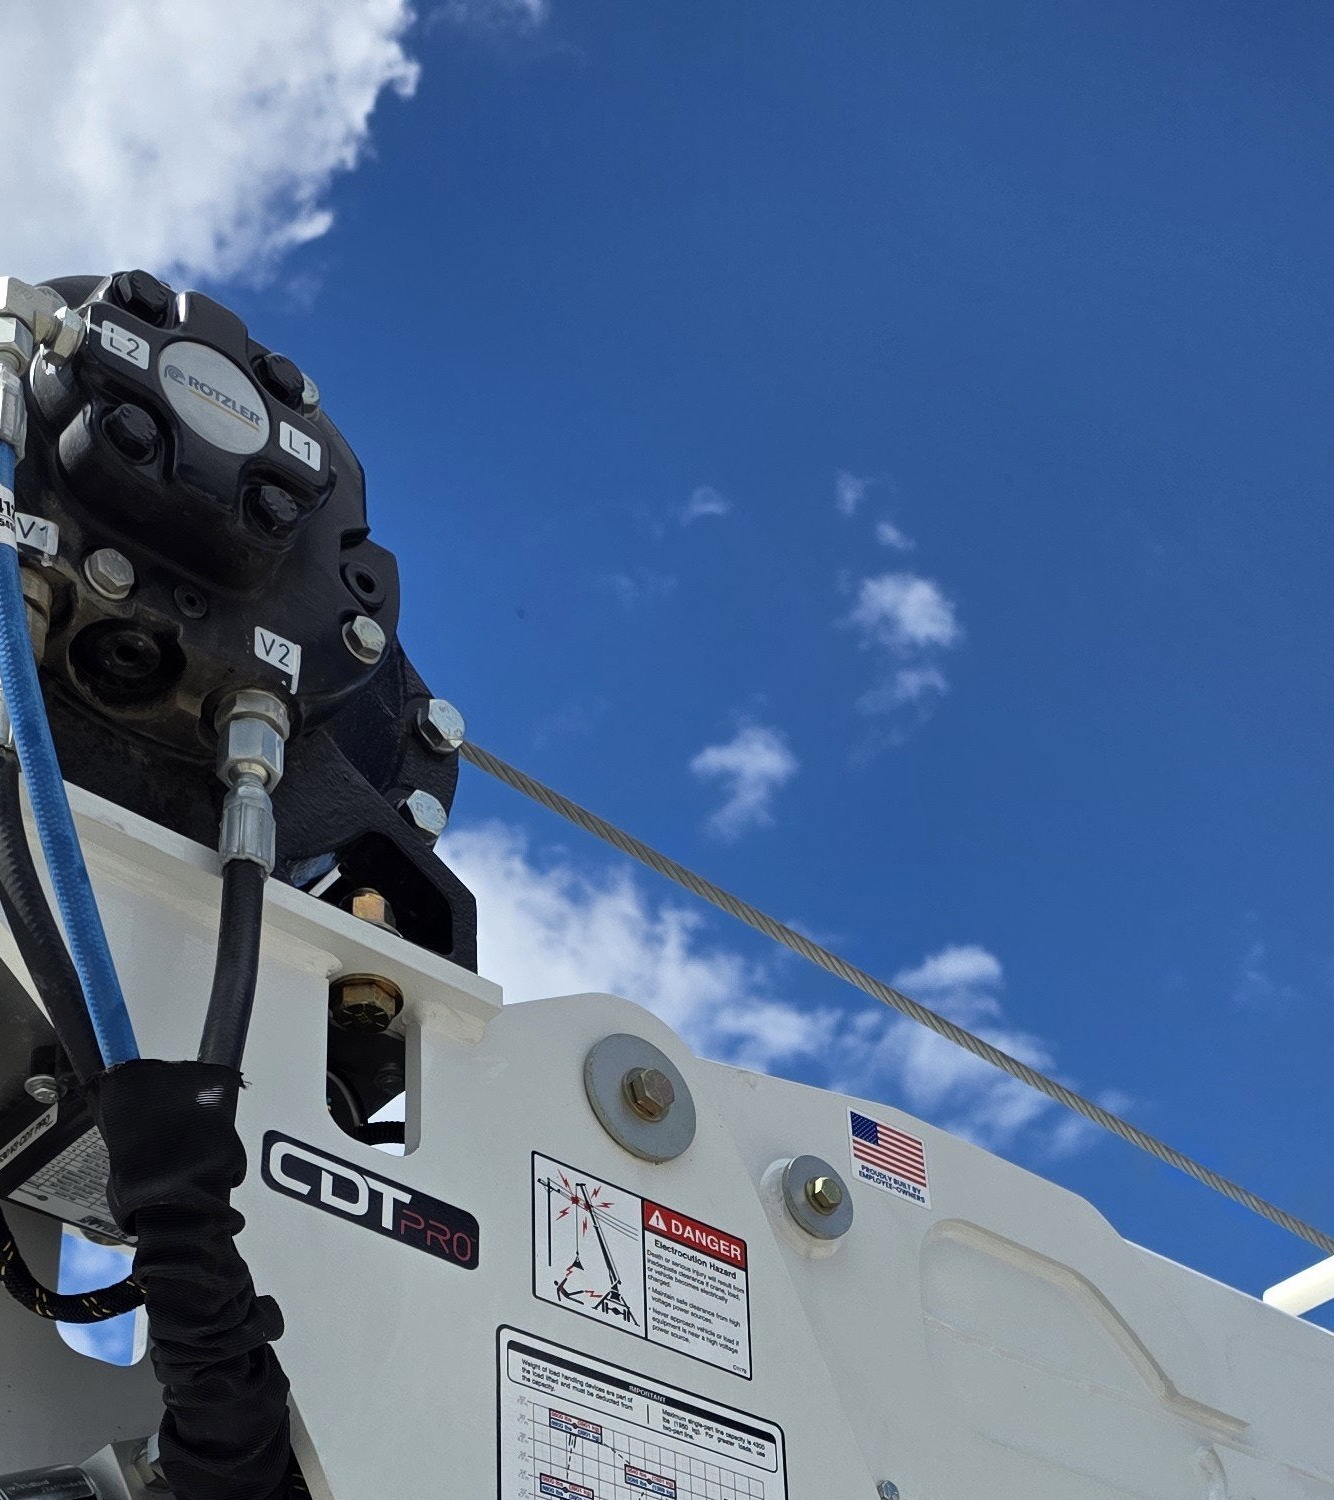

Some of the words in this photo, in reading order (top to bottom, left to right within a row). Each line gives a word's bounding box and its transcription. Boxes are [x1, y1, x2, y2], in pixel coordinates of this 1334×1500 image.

[109, 328, 139, 361] L2
[187, 375, 261, 427] ROTZLER
[289, 430, 312, 461] L1
[17, 516, 48, 546] V1
[260, 632, 289, 667] V2
[861, 1164, 892, 1182] PROUDLY
[893, 1178, 911, 1190] BUILT
[912, 1186, 921, 1195] BY
[671, 1218, 740, 1260] DANGER
[654, 1238, 706, 1267] Electrocution
[709, 1261, 736, 1279] Hazard
[654, 1269, 673, 1280] vehicle
[674, 1277, 699, 1291] becomes
[700, 1287, 728, 1304] electrically
[678, 1271, 703, 1285] clearance
[692, 1268, 706, 1280] injury
[717, 1279, 731, 1288] result
[733, 1285, 744, 1294] from
[651, 1295, 671, 1308] voltage
[672, 1304, 688, 1315] power
[651, 1286, 674, 1301] Maintain
[688, 1302, 714, 1317] clearance
[716, 1312, 727, 1322] from
[729, 1318, 740, 1328] high
[652, 1307, 668, 1318] Never
[670, 1314, 695, 1330] approach
[696, 1325, 714, 1337] vehicle
[723, 1335, 734, 1344] load
[652, 1323, 667, 1335] power
[652, 1315, 680, 1332] equipment
[688, 1330, 699, 1339] near
[706, 1336, 717, 1347] high
[718, 1342, 738, 1355] voltage
[629, 1385, 666, 1403] IMPORTANT
